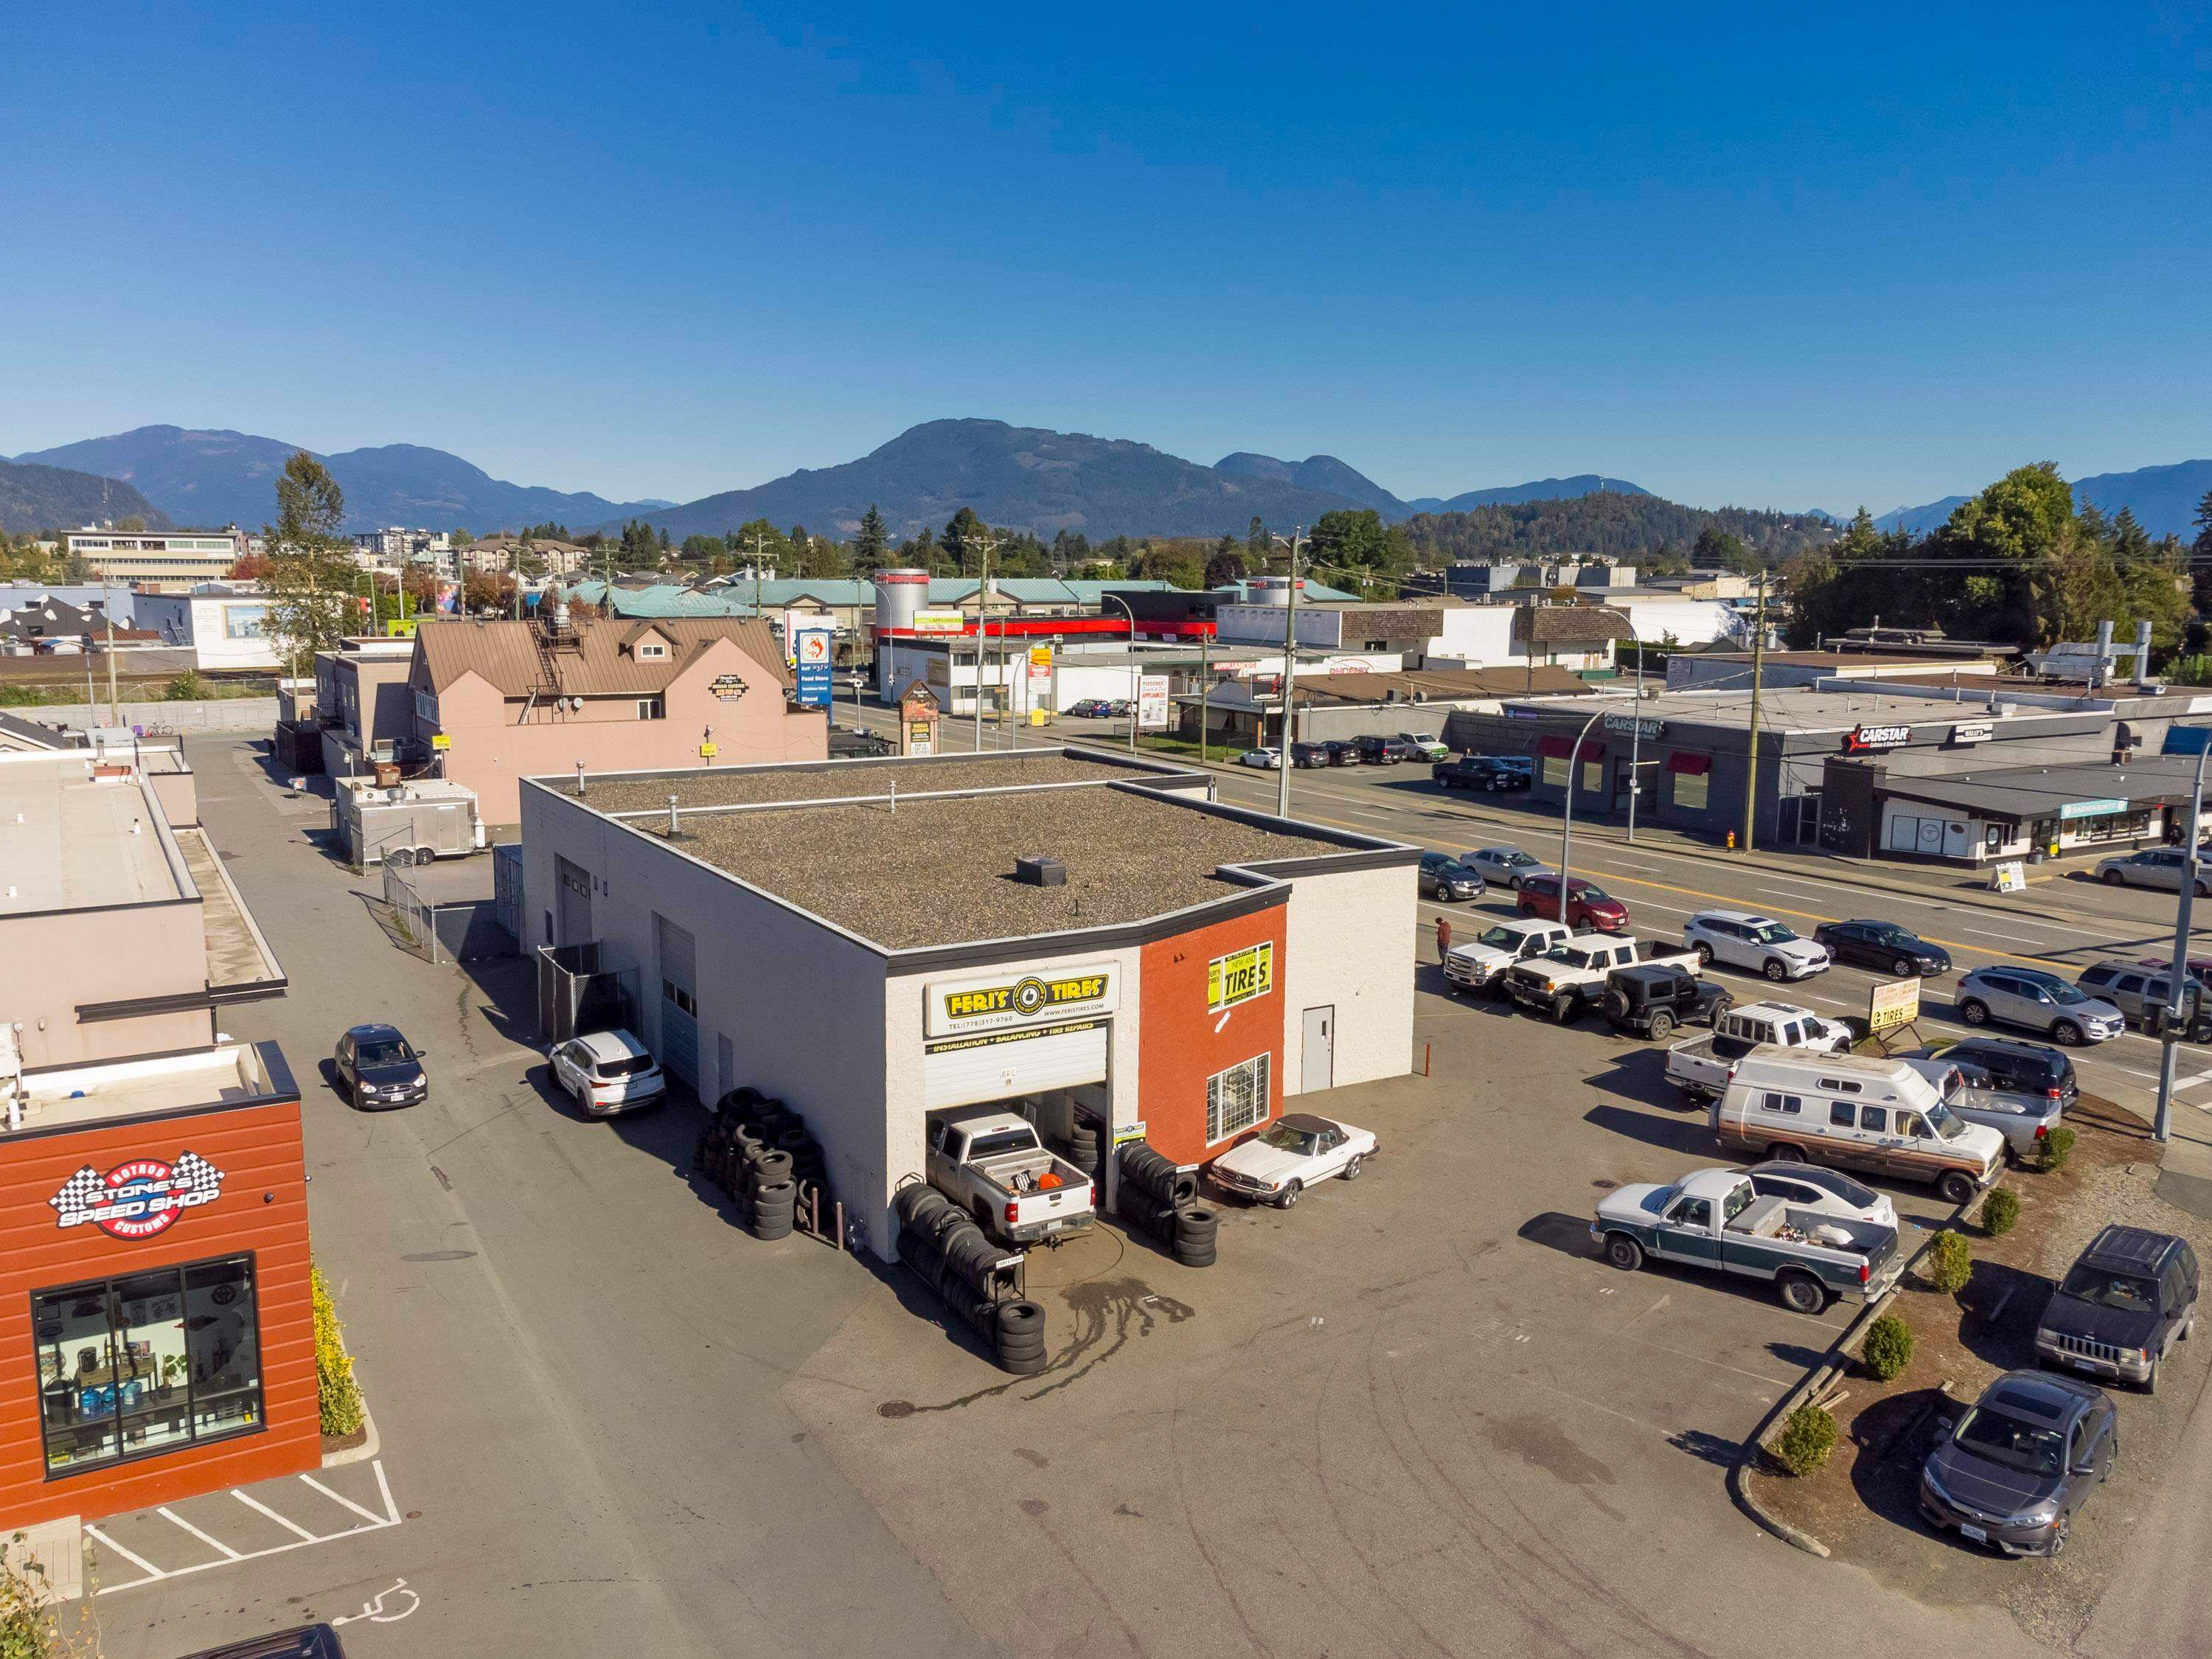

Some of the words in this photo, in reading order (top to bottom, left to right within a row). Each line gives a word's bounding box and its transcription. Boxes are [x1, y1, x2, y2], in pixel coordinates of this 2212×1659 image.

[1214, 662, 1256, 670] APPLIANCES
[1860, 727, 1909, 742] CARSTAR
[1232, 959, 1244, 968] NEW
[1210, 969, 1220, 978] ERI'S
[1225, 961, 1267, 995] TIRES
[951, 991, 1009, 1015] FERI'S
[1051, 978, 1102, 1001] TIRES
[1044, 1004, 1104, 1016] WWW.FERISTIRES.COM
[1884, 1008, 1903, 1023] TIRES
[996, 1030, 1040, 1043] BALANCING
[111, 1164, 166, 1184] HOTROD
[86, 1177, 192, 1203] STONE'S
[58, 1201, 145, 1228] SPEED
[148, 1189, 220, 1213] SHOP
[114, 1214, 170, 1234] CUSTOMS
